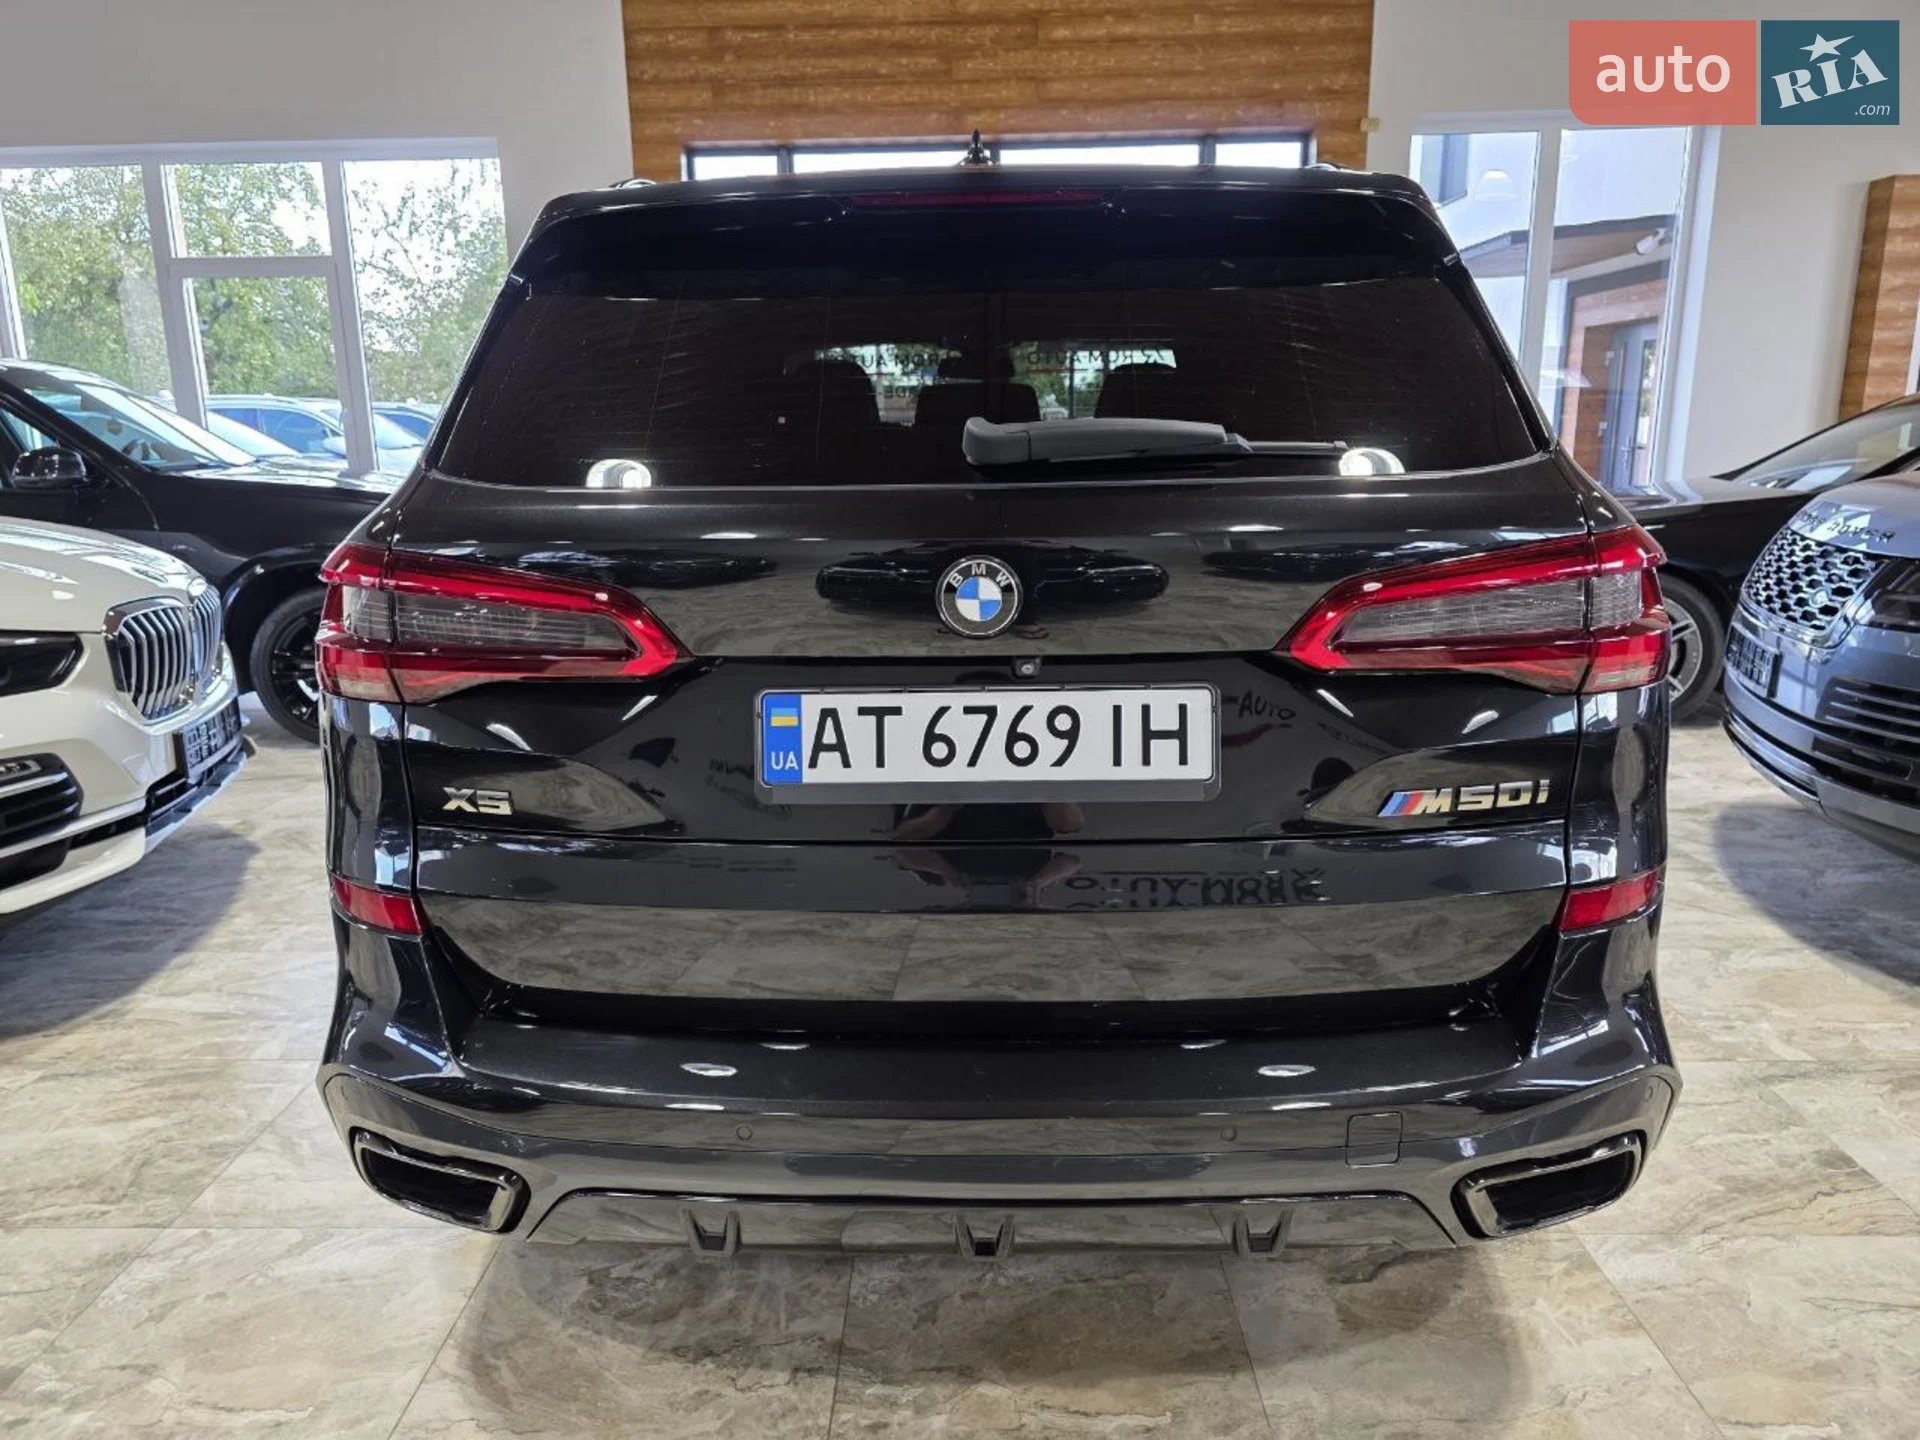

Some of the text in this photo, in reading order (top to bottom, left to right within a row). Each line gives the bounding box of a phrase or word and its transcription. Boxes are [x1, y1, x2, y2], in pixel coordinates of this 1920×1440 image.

[948, 563, 1011, 588] BMW
[807, 702, 1189, 769] AT 6769 IH
[770, 751, 799, 771] UA
[443, 787, 513, 815] X5
[1405, 779, 1551, 816] M50i
